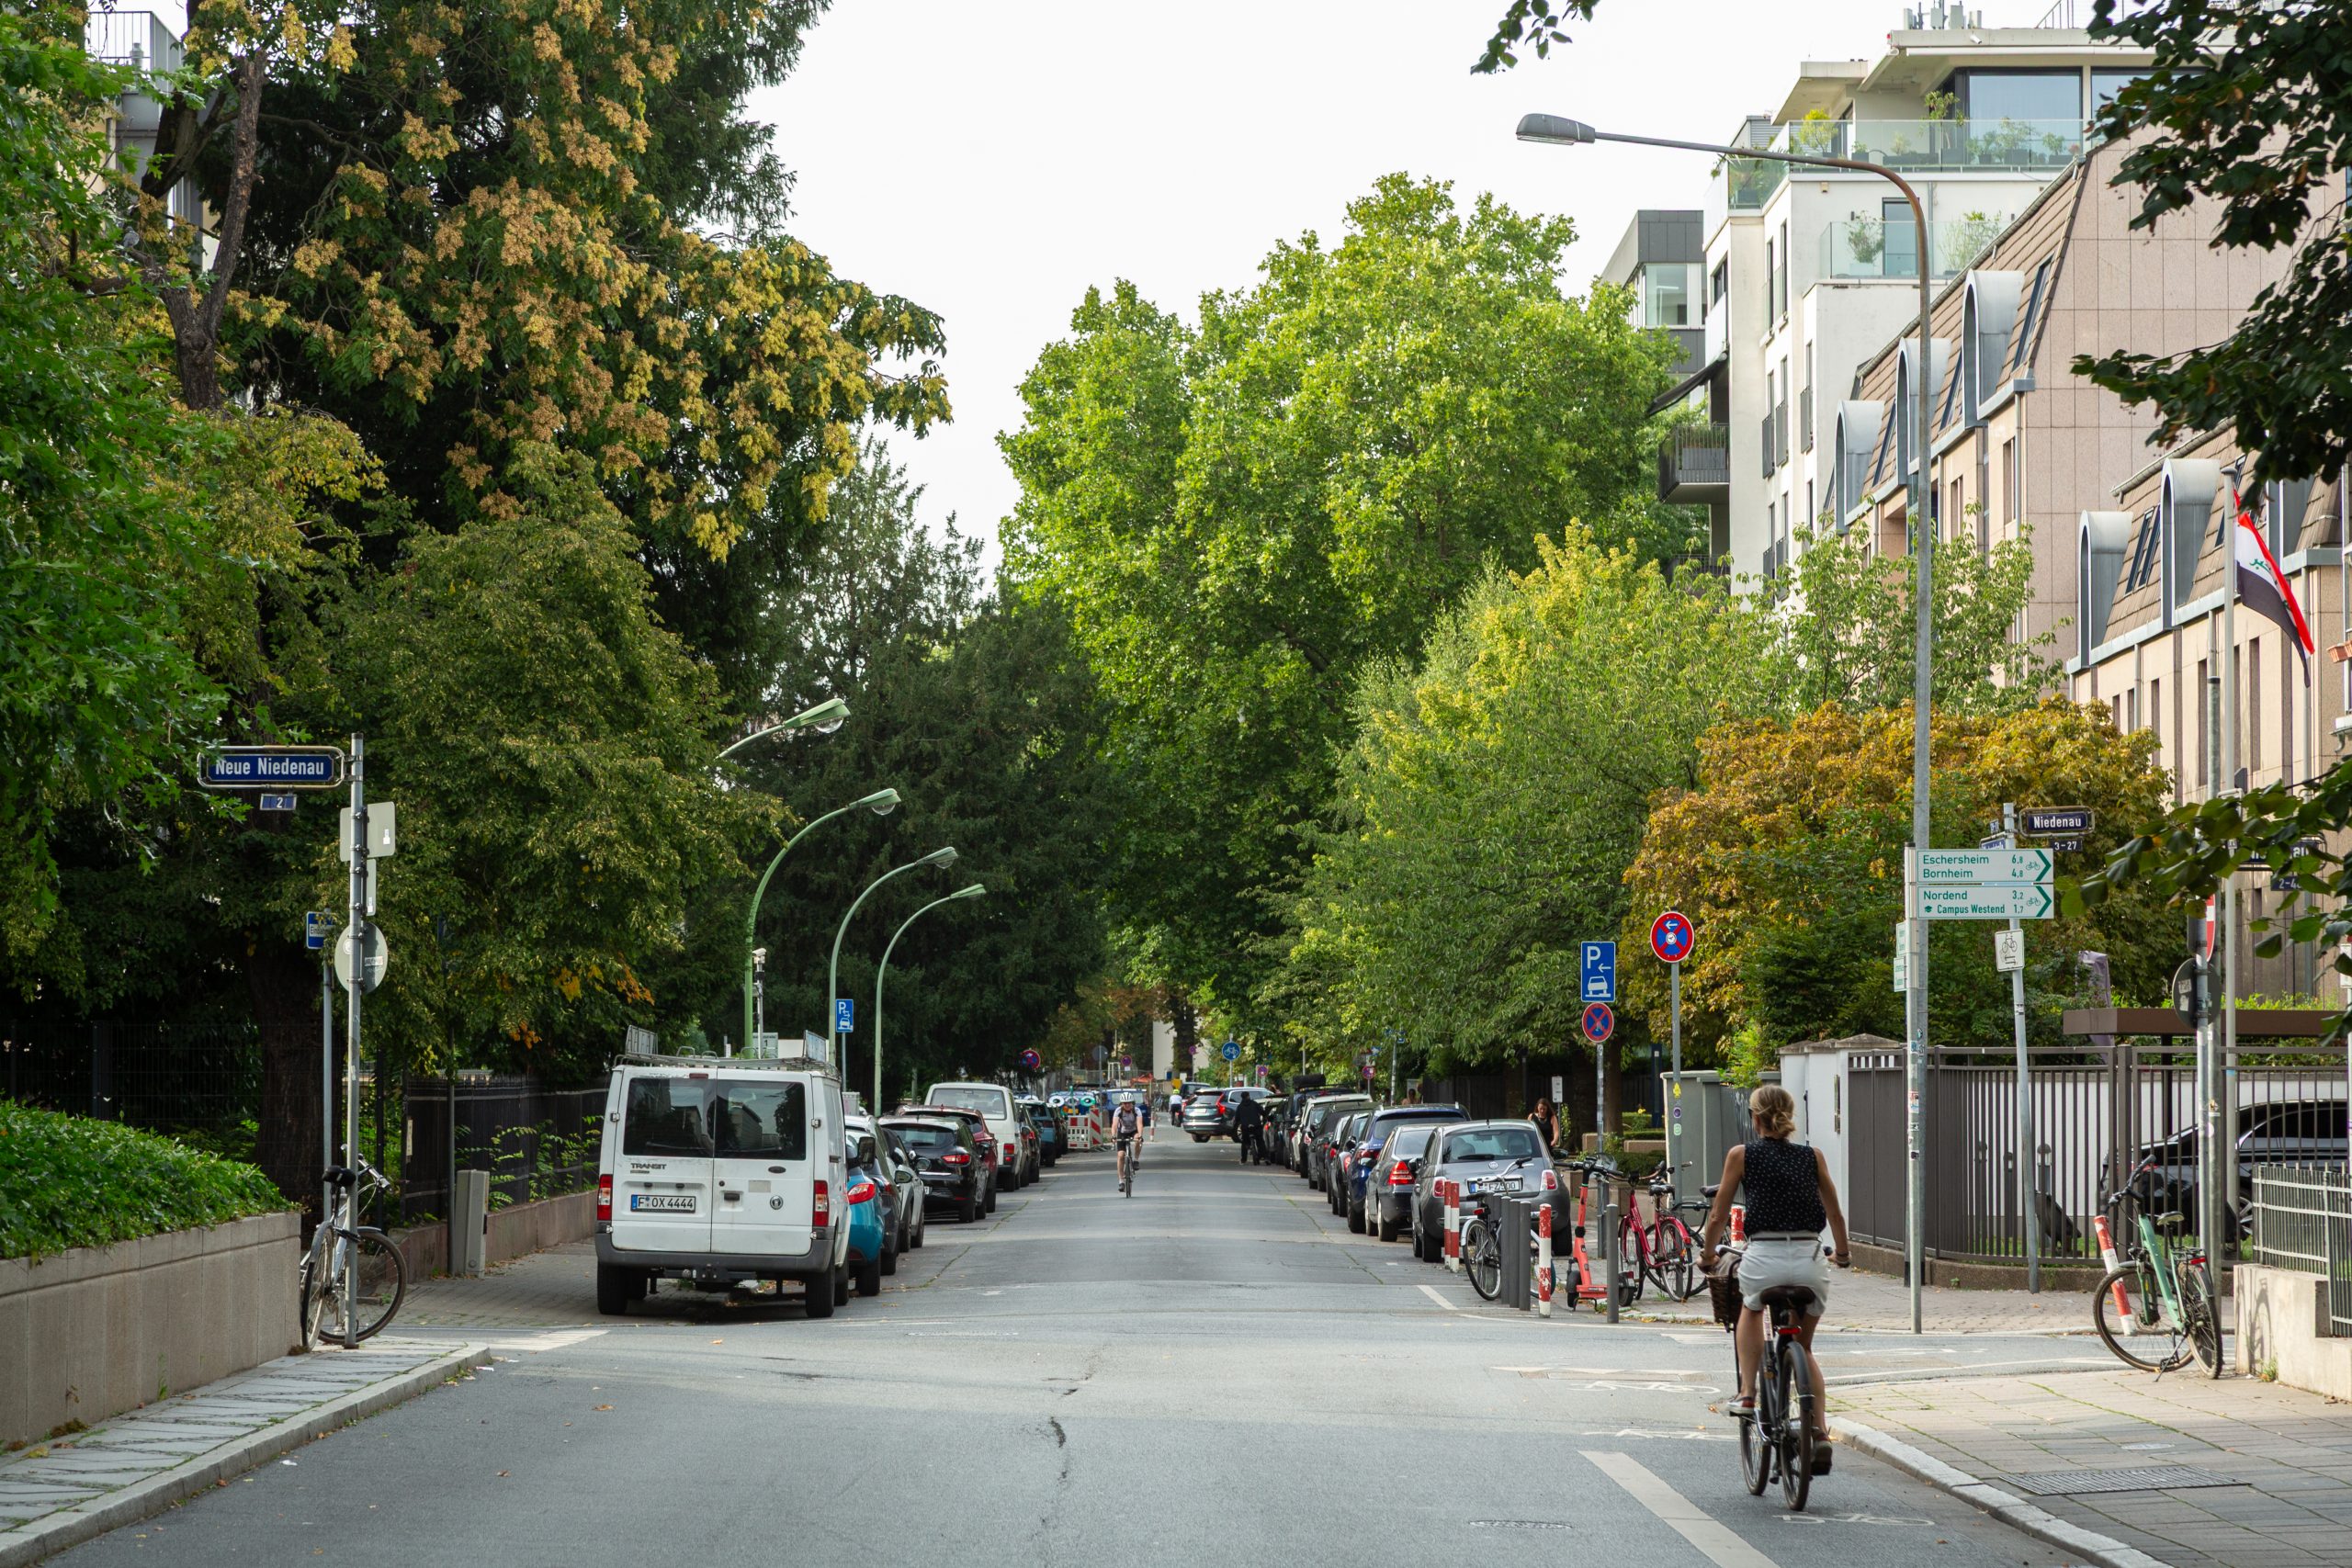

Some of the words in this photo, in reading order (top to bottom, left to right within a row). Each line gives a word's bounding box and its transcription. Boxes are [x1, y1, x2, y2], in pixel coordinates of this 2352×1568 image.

[216, 759, 251, 775] Neue
[257, 758, 324, 775] Niedenau
[277, 797, 283, 808] 2
[2033, 816, 2082, 829] Niedenau
[1923, 854, 1989, 864] Eschersheim
[1923, 868, 1973, 878] Bornheim
[1923, 890, 1968, 900] Nordend
[1937, 904, 1969, 916] Campus
[1971, 904, 2006, 914] Westend
[1587, 945, 1601, 969] P
[838, 1001, 846, 1014] P
[630, 1162, 667, 1170] TRANSIT
[667, 1198, 693, 1209] 4444
